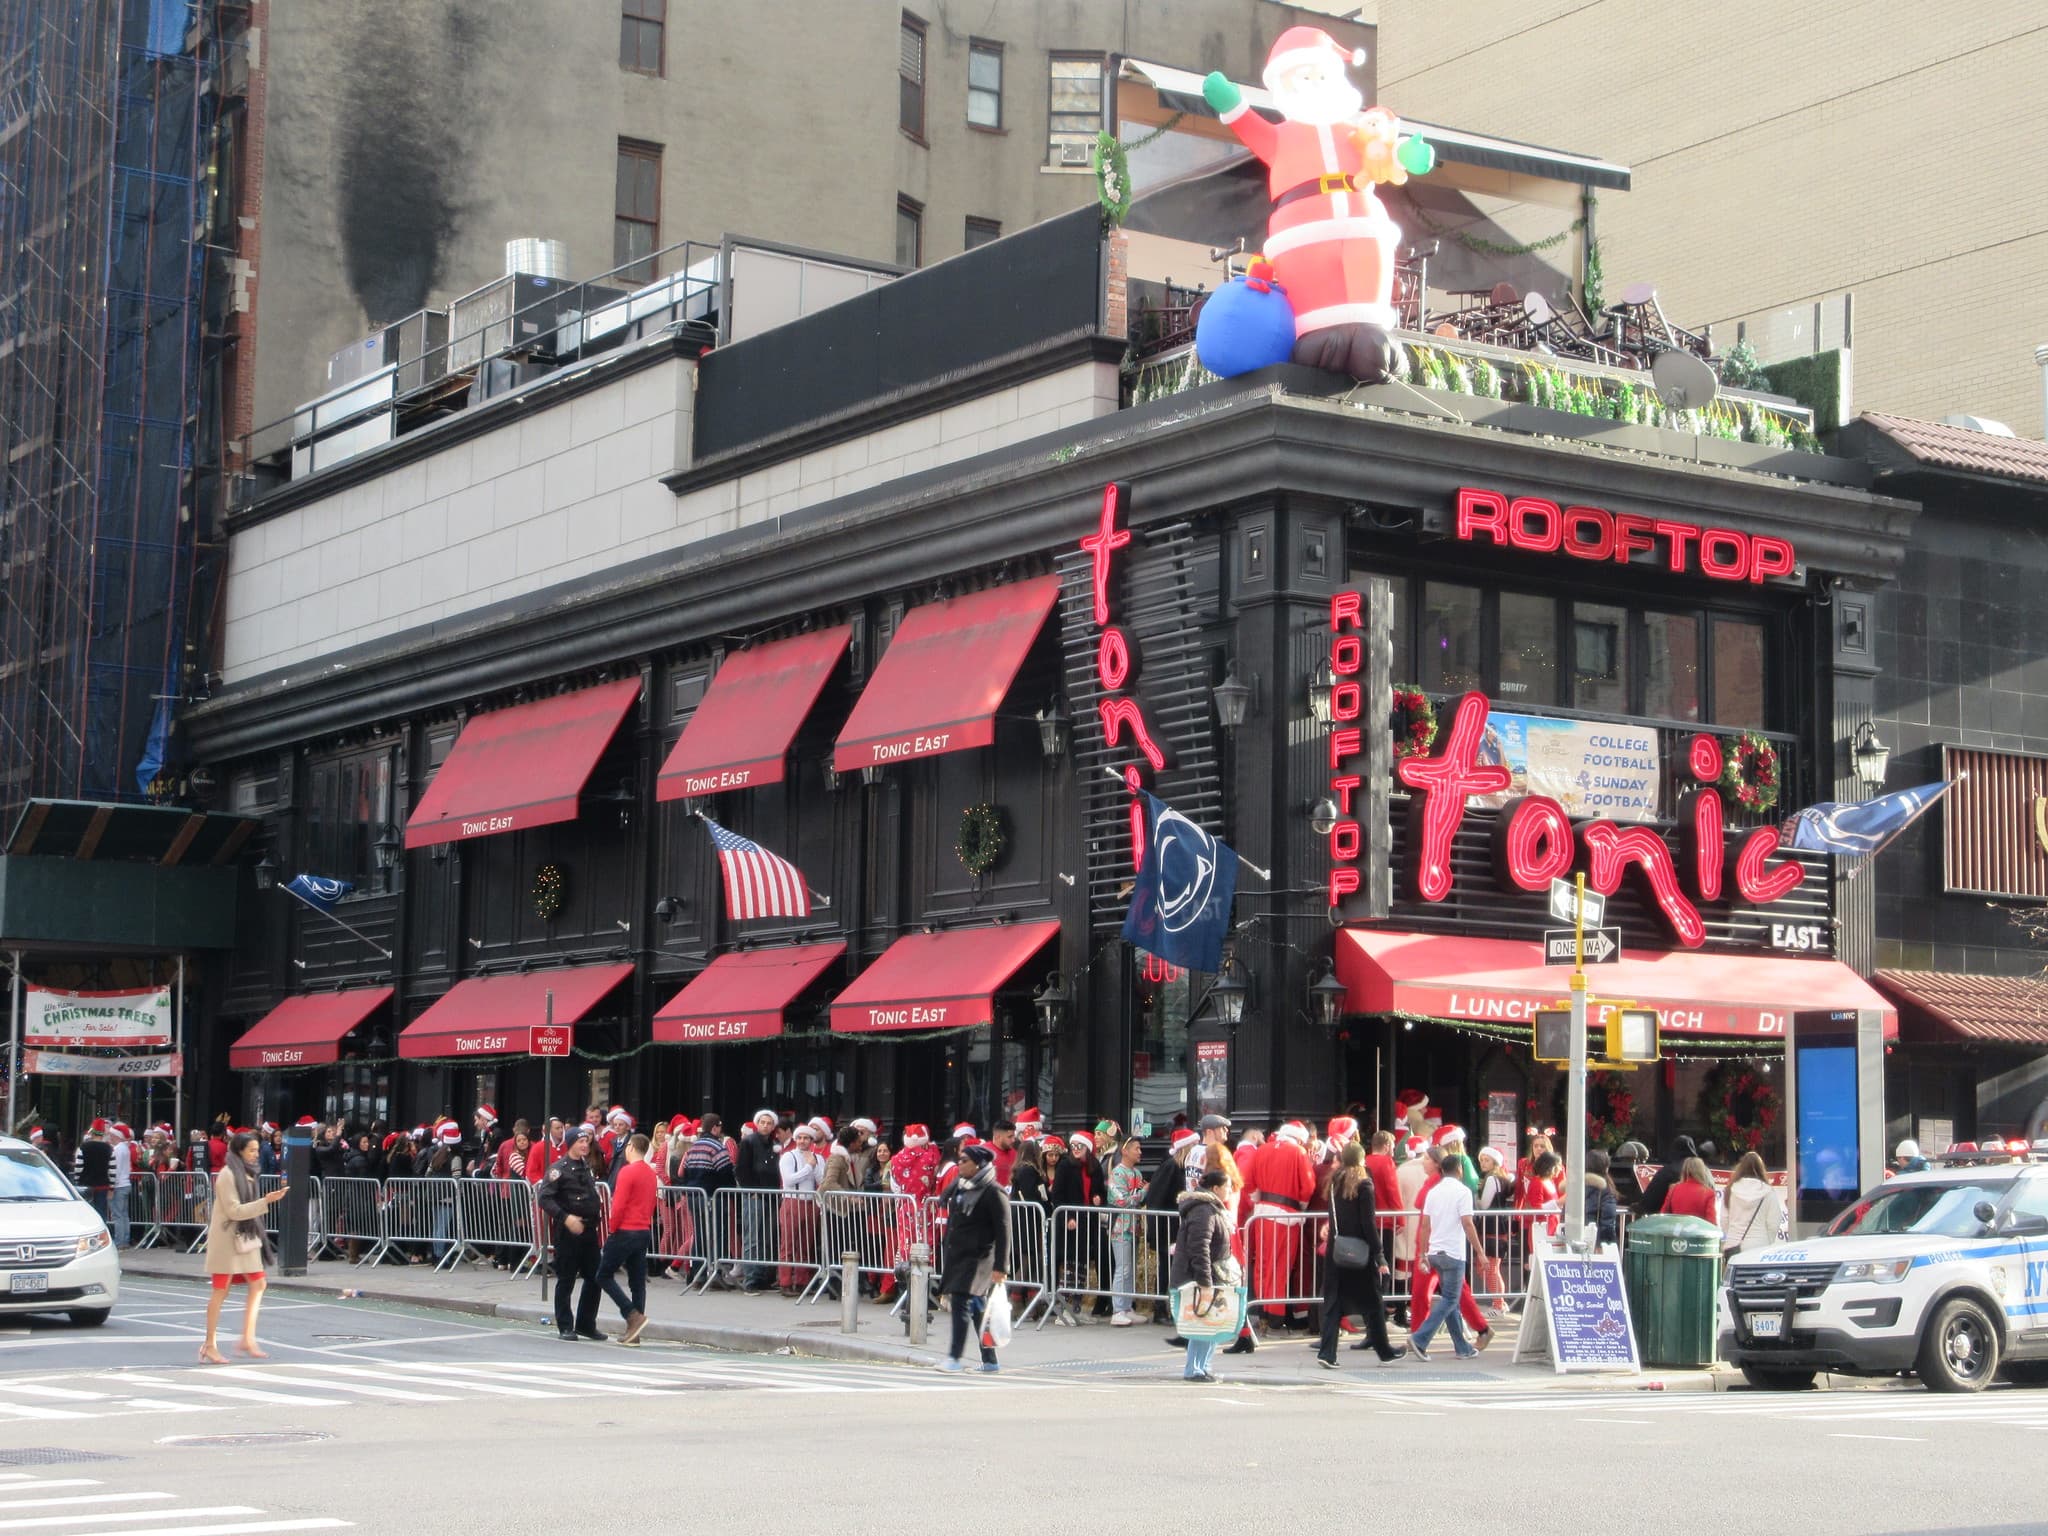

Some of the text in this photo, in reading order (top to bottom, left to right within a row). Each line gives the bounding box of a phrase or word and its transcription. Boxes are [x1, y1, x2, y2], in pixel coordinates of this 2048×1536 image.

[1457, 487, 1795, 584] ROOFTOP
[1331, 590, 1363, 907] ROOFTOP
[1590, 736, 1649, 751] COLLEGE
[1583, 754, 1656, 770] FOOTBALL
[1594, 776, 1648, 790] SUNDAY
[1400, 691, 1805, 947] tonic
[1771, 924, 1822, 949] EAST
[1555, 940, 1607, 955] ONE WAY
[1449, 995, 1541, 1019] LUNCH
[44, 1007, 157, 1026] CHRISTMAS TREES
[537, 1037, 563, 1045] WRONG
[1760, 1253, 1808, 1262] POLICE
[1929, 1251, 1962, 1264] POLICE
[1547, 1264, 1580, 1278] Chakra
[1561, 1280, 1608, 1299] Readings
